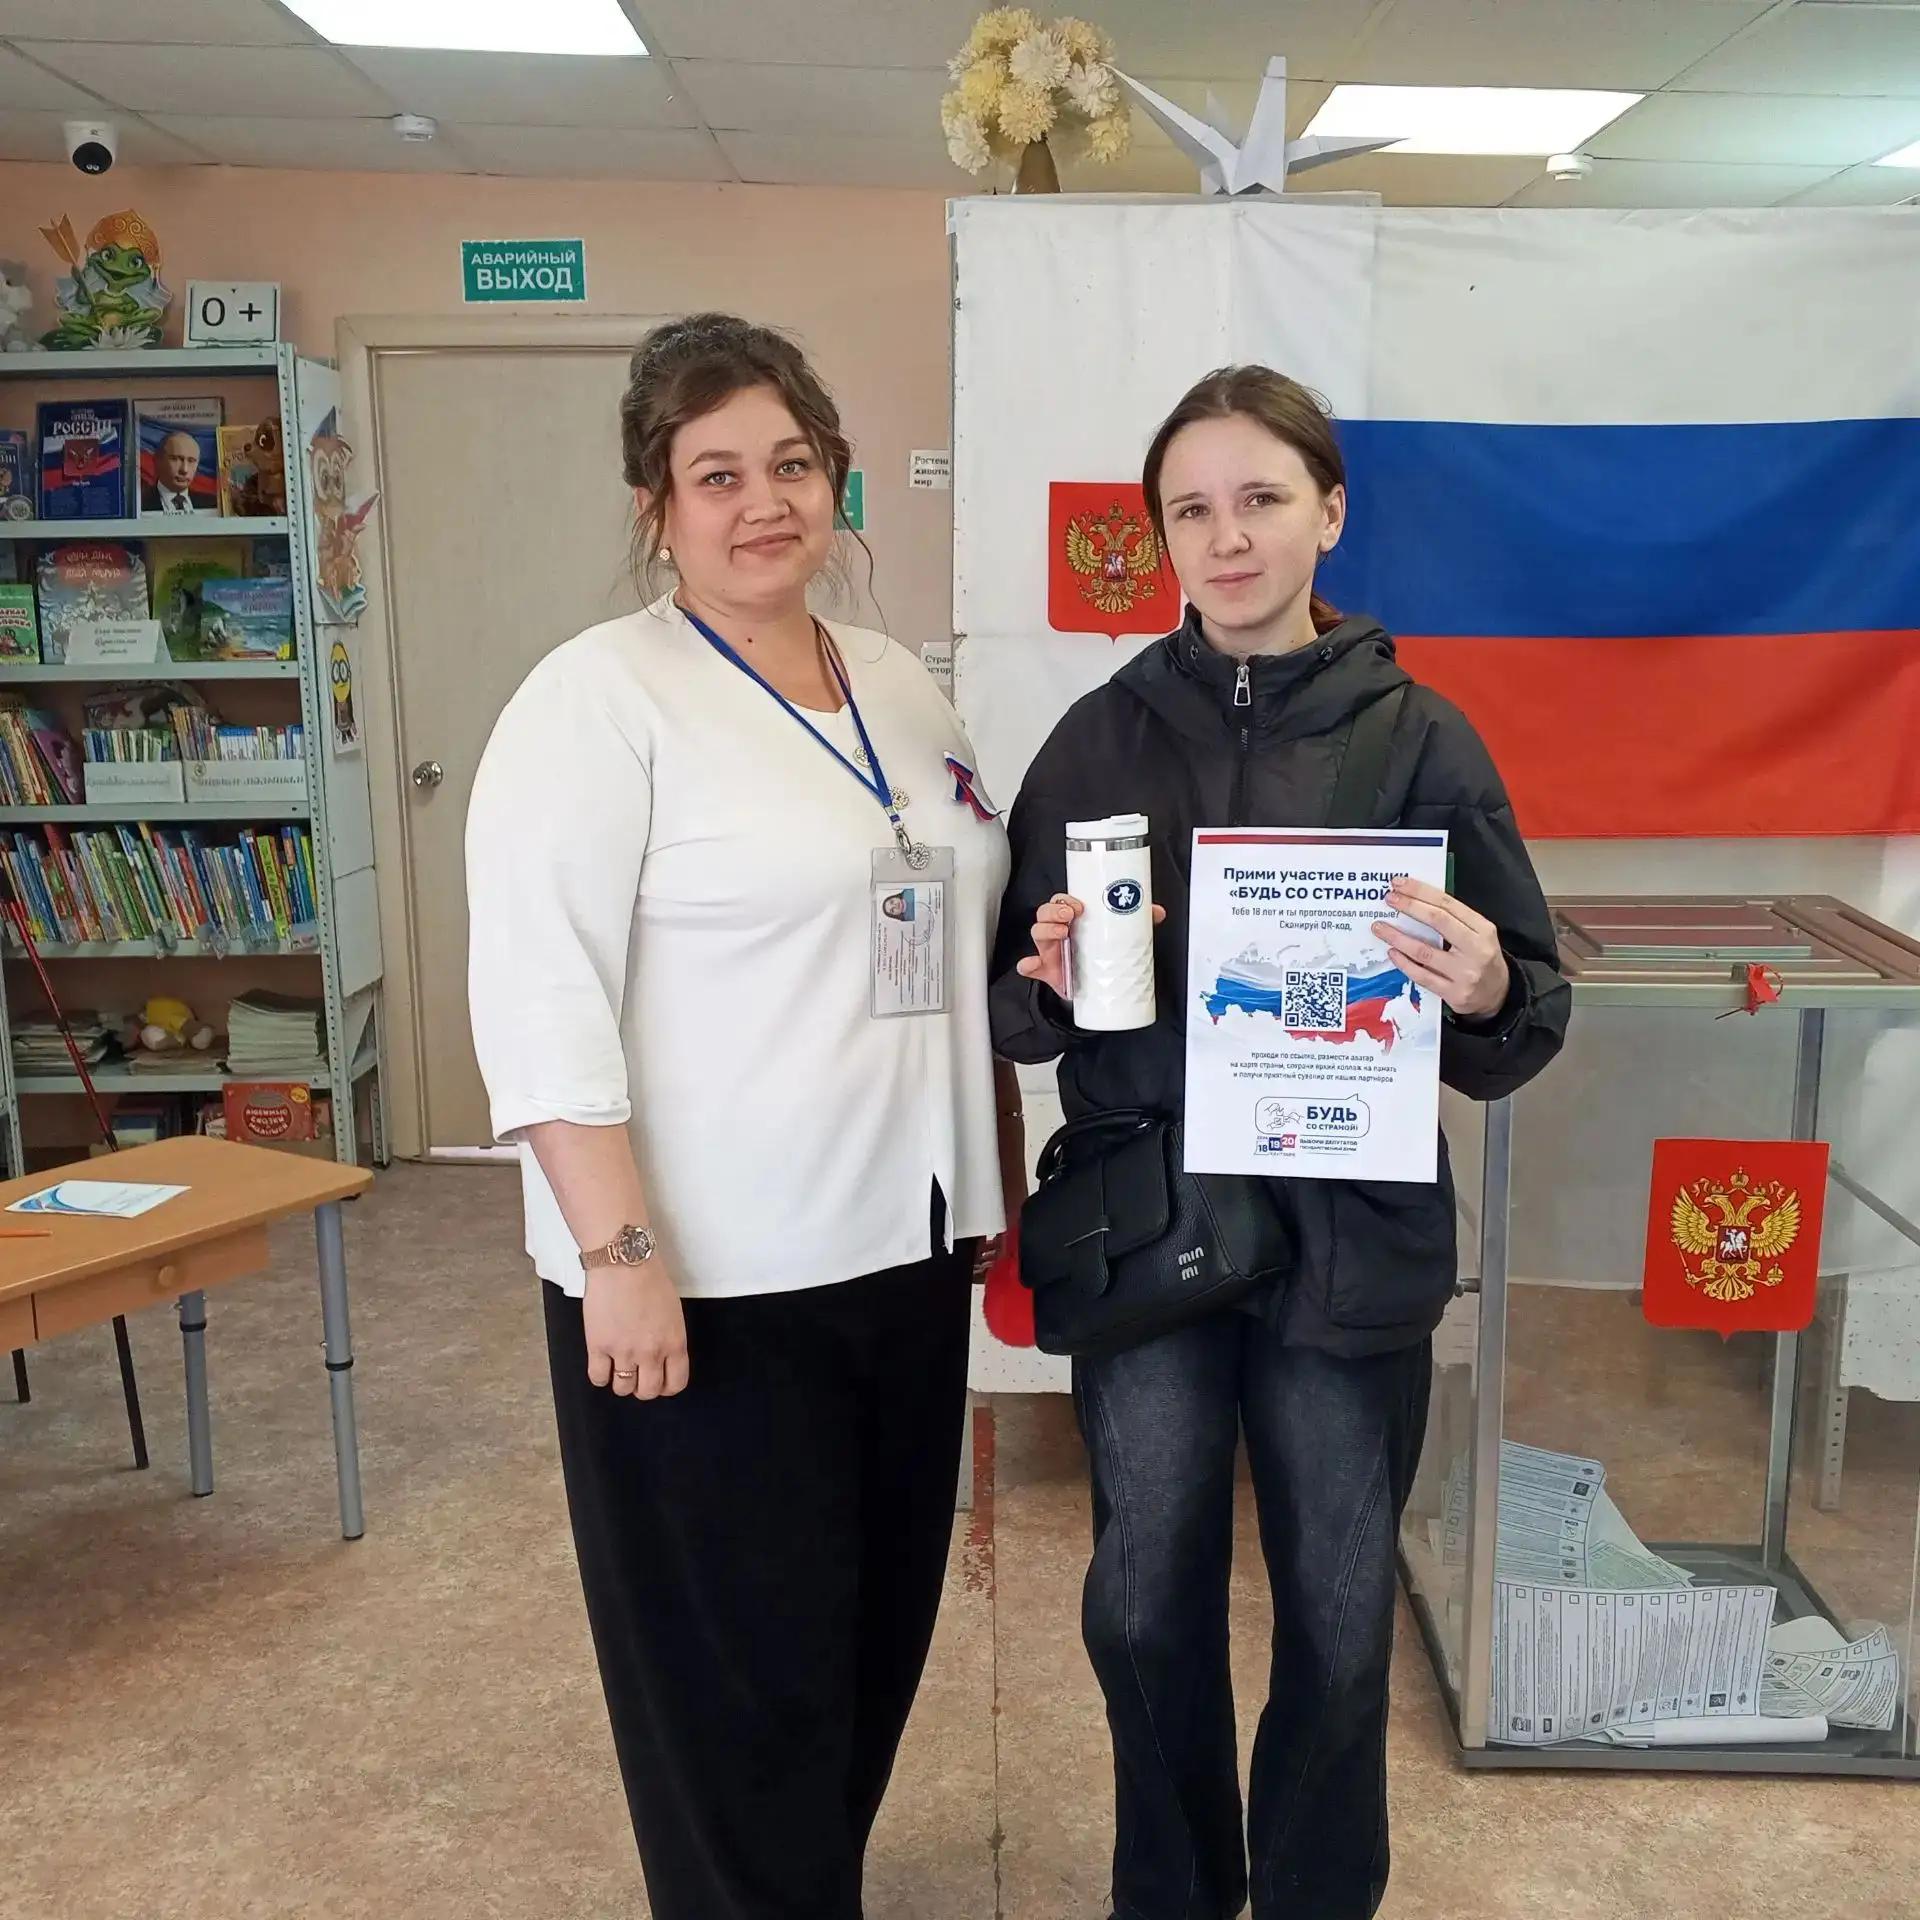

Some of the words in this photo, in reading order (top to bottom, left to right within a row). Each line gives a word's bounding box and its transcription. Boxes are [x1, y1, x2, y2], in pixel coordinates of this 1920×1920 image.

[471, 249, 576, 265] АВАРИЙНЫЙ
[477, 267, 573, 293] ВЫХОД
[914, 479, 932, 488] мир
[1224, 868, 1276, 882] Прими
[1280, 871, 1344, 883] участие
[1348, 872, 1357, 880] в
[1229, 886, 1281, 900] «БУДЬ
[1285, 887, 1308, 899] СО
[1231, 907, 1250, 917] Тебе
[1252, 908, 1260, 916] 18
[1299, 910, 1356, 919] проголосовал
[1359, 910, 1400, 919] впервые?
[1279, 921, 1319, 931] Сканируй
[1307, 1106, 1358, 1123] БУДЬ
[1258, 1144, 1268, 1152] 18
[1270, 1140, 1280, 1149] 19
[1282, 1137, 1295, 1146] 20
